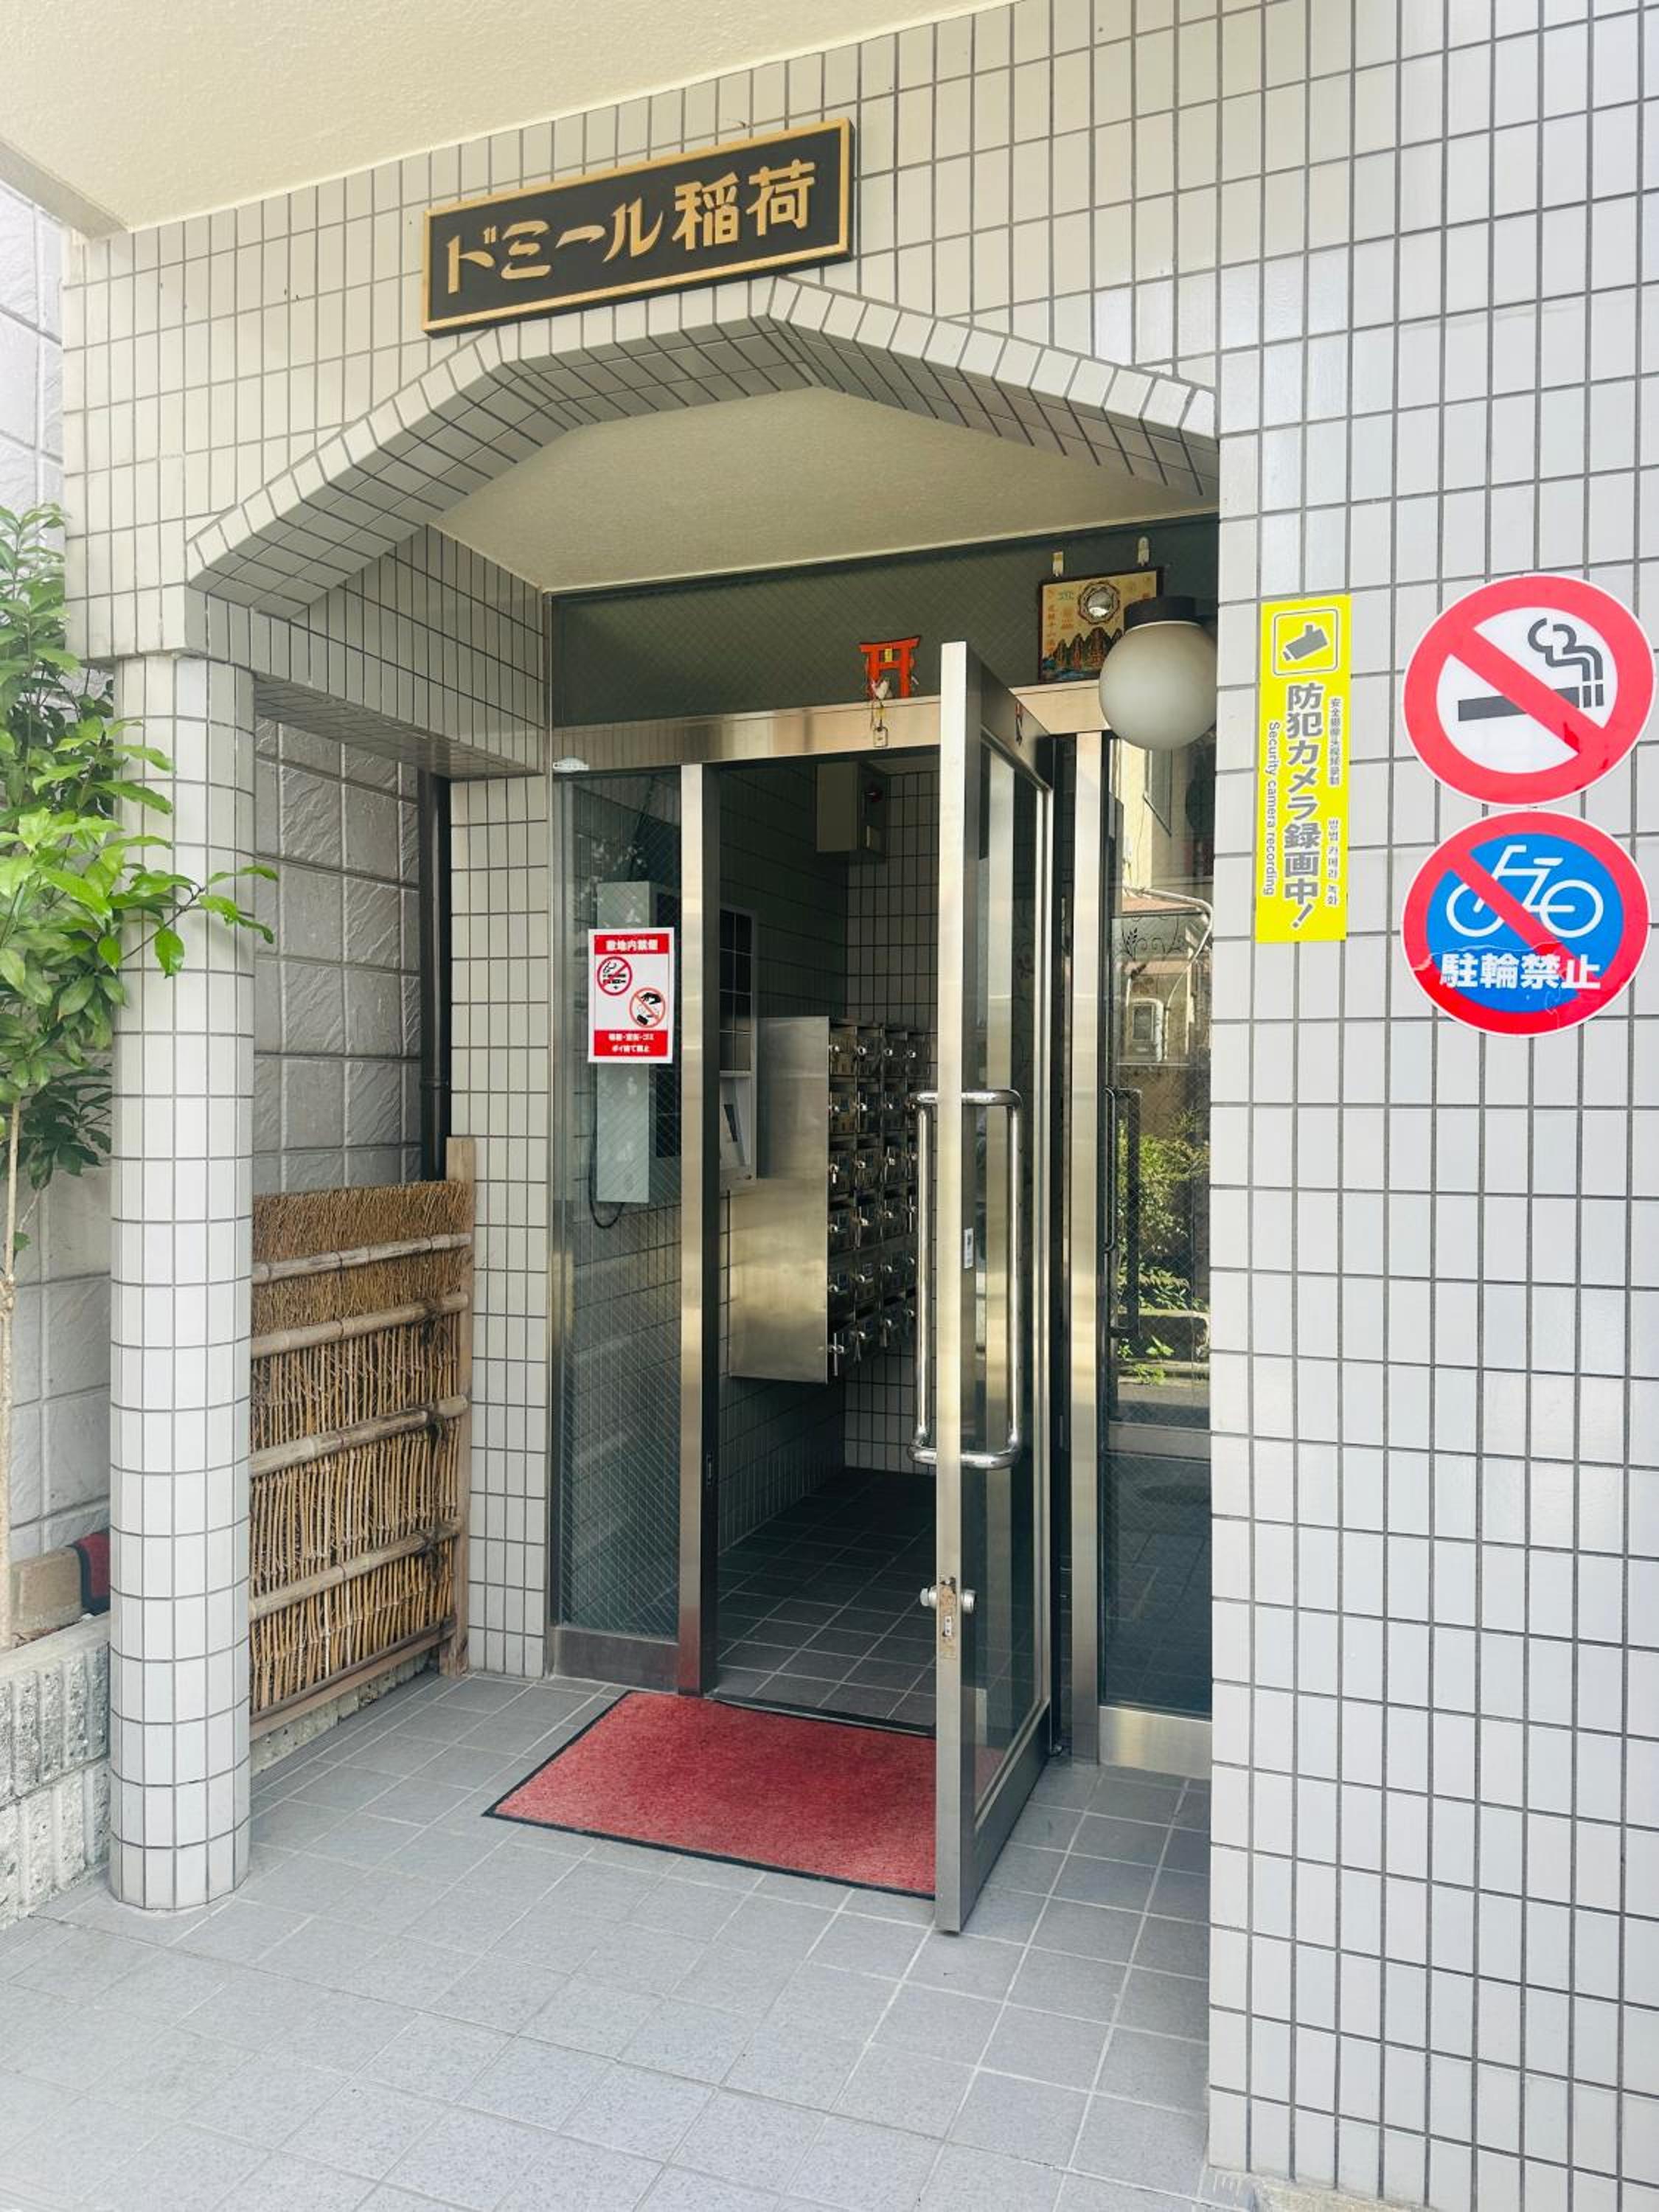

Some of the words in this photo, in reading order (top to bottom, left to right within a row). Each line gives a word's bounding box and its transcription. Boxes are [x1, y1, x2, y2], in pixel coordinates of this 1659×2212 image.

[447, 158, 815, 293] ドミール稲荷
[1265, 721, 1280, 775] Security
[1267, 779, 1276, 828] camera
[1262, 832, 1277, 896] recording
[1439, 952, 1602, 991] 駐輪禁止
